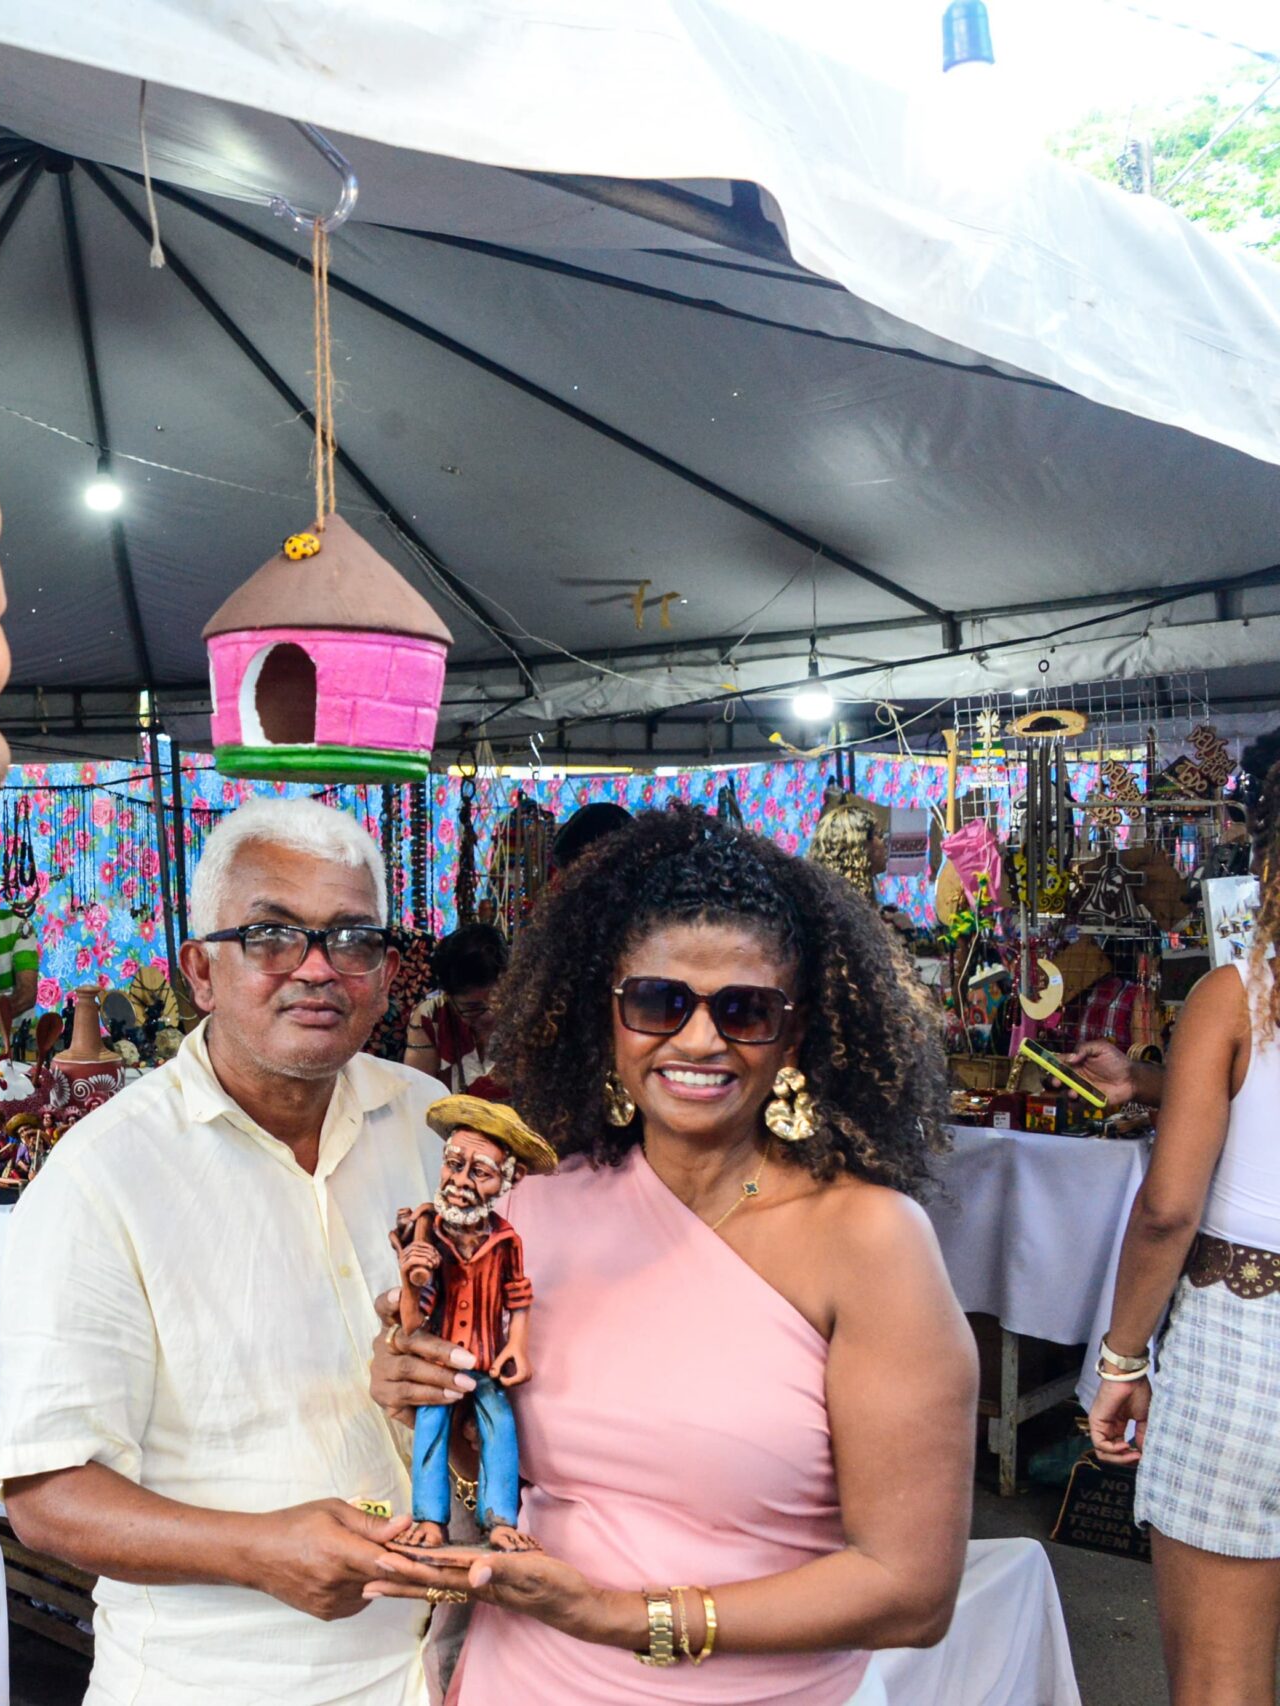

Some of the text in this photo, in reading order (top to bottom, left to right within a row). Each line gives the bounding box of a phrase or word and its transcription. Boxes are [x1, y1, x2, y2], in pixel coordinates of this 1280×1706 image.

[1100, 1478, 1130, 1494] NO
[1079, 1488, 1129, 1507] VALE
[1068, 1513, 1132, 1537] TERRA
